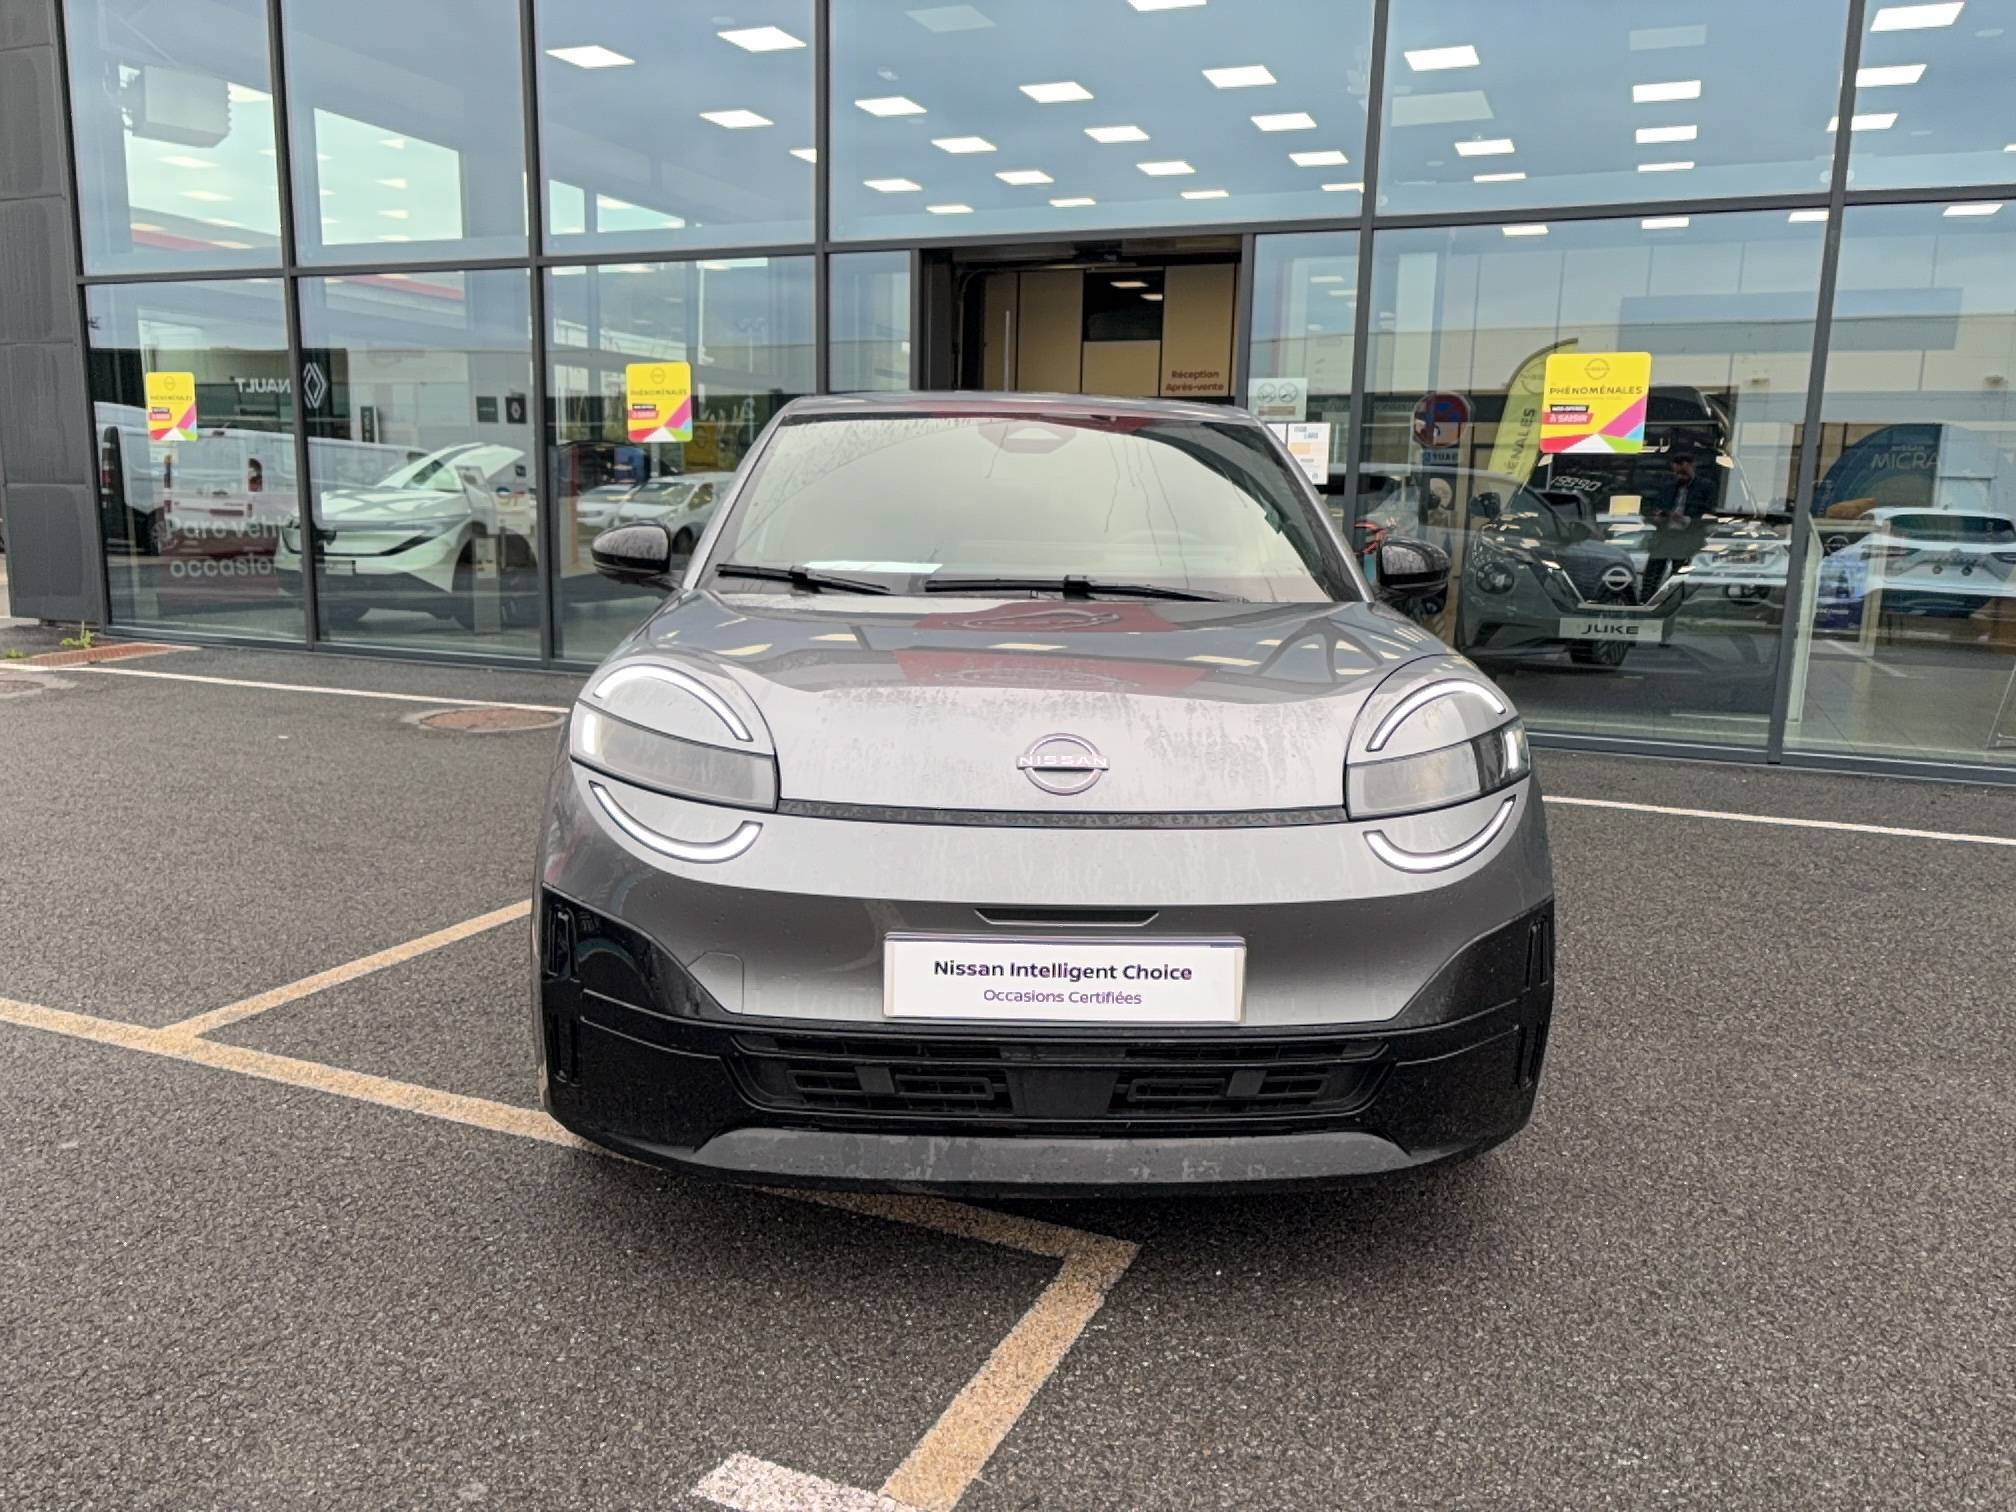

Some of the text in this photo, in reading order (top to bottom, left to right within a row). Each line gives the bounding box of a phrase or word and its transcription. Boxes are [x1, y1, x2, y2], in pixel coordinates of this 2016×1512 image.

[1171, 369, 1220, 381] Réception
[1549, 384, 1643, 395] PHÉNOMÉNALES
[1580, 623, 1640, 635] JUKE
[1019, 755, 1107, 767] NISSAN
[933, 960, 1193, 982] Nissan Intelligent Choice
[983, 989, 1143, 1006] Occasions Certifiées
